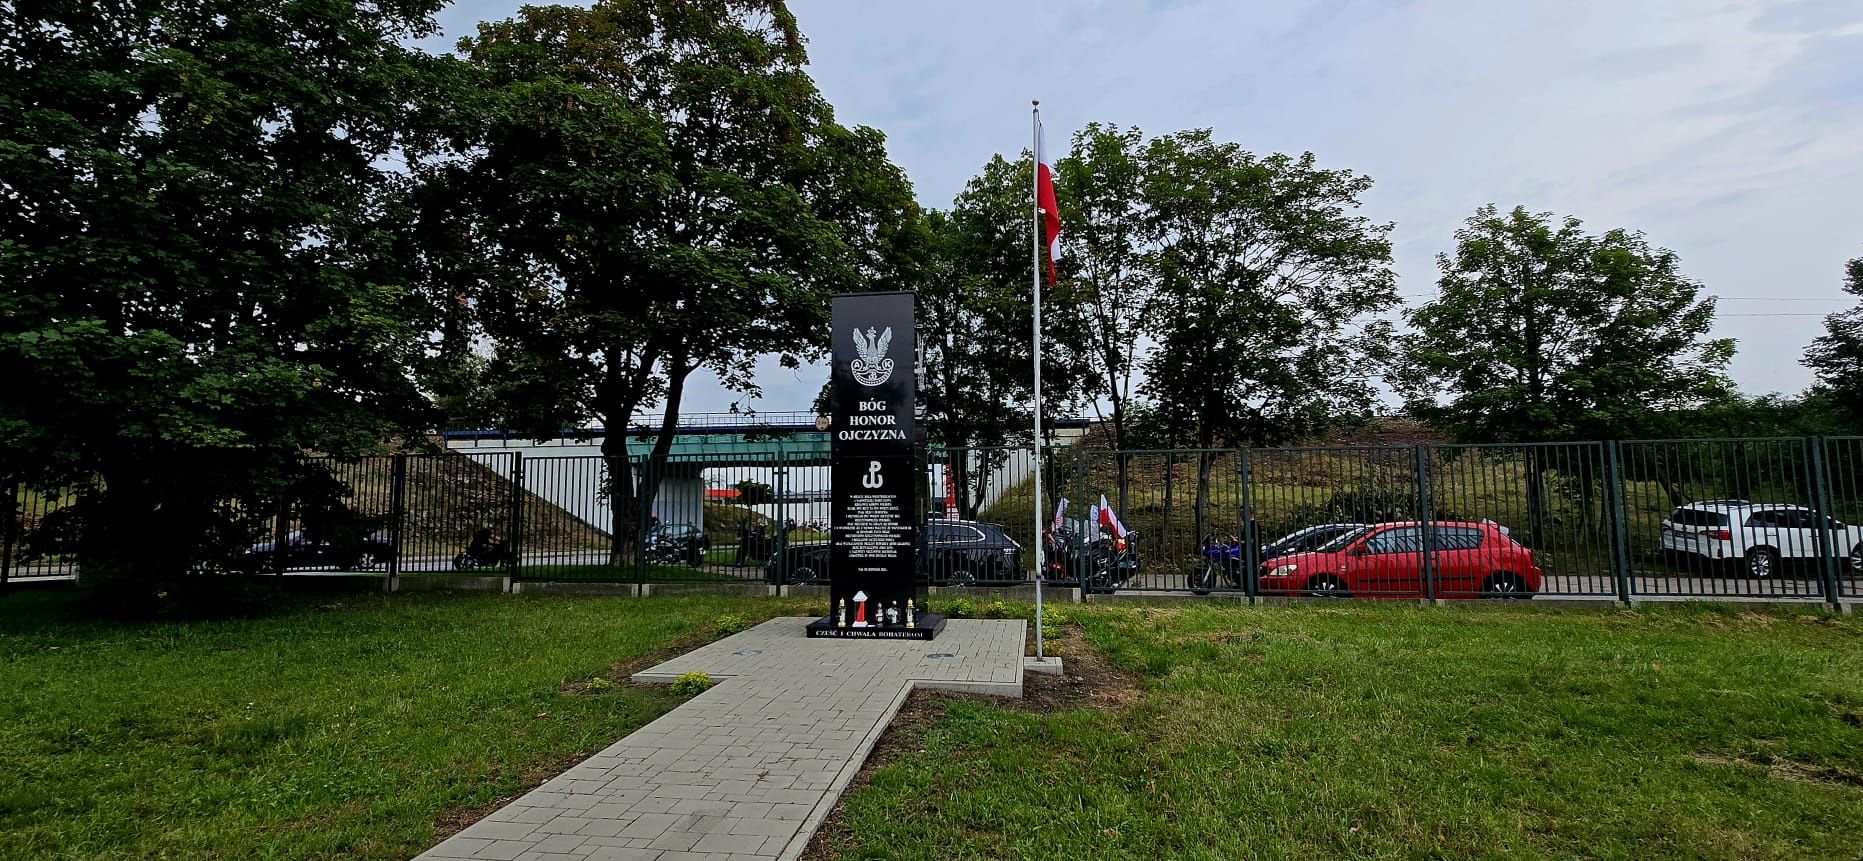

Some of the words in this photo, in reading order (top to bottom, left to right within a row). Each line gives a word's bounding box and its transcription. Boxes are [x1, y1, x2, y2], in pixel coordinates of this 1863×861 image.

[859, 397, 887, 411] BÓG
[849, 415, 896, 426] HONOR
[838, 429, 907, 441] OJCZYZNA
